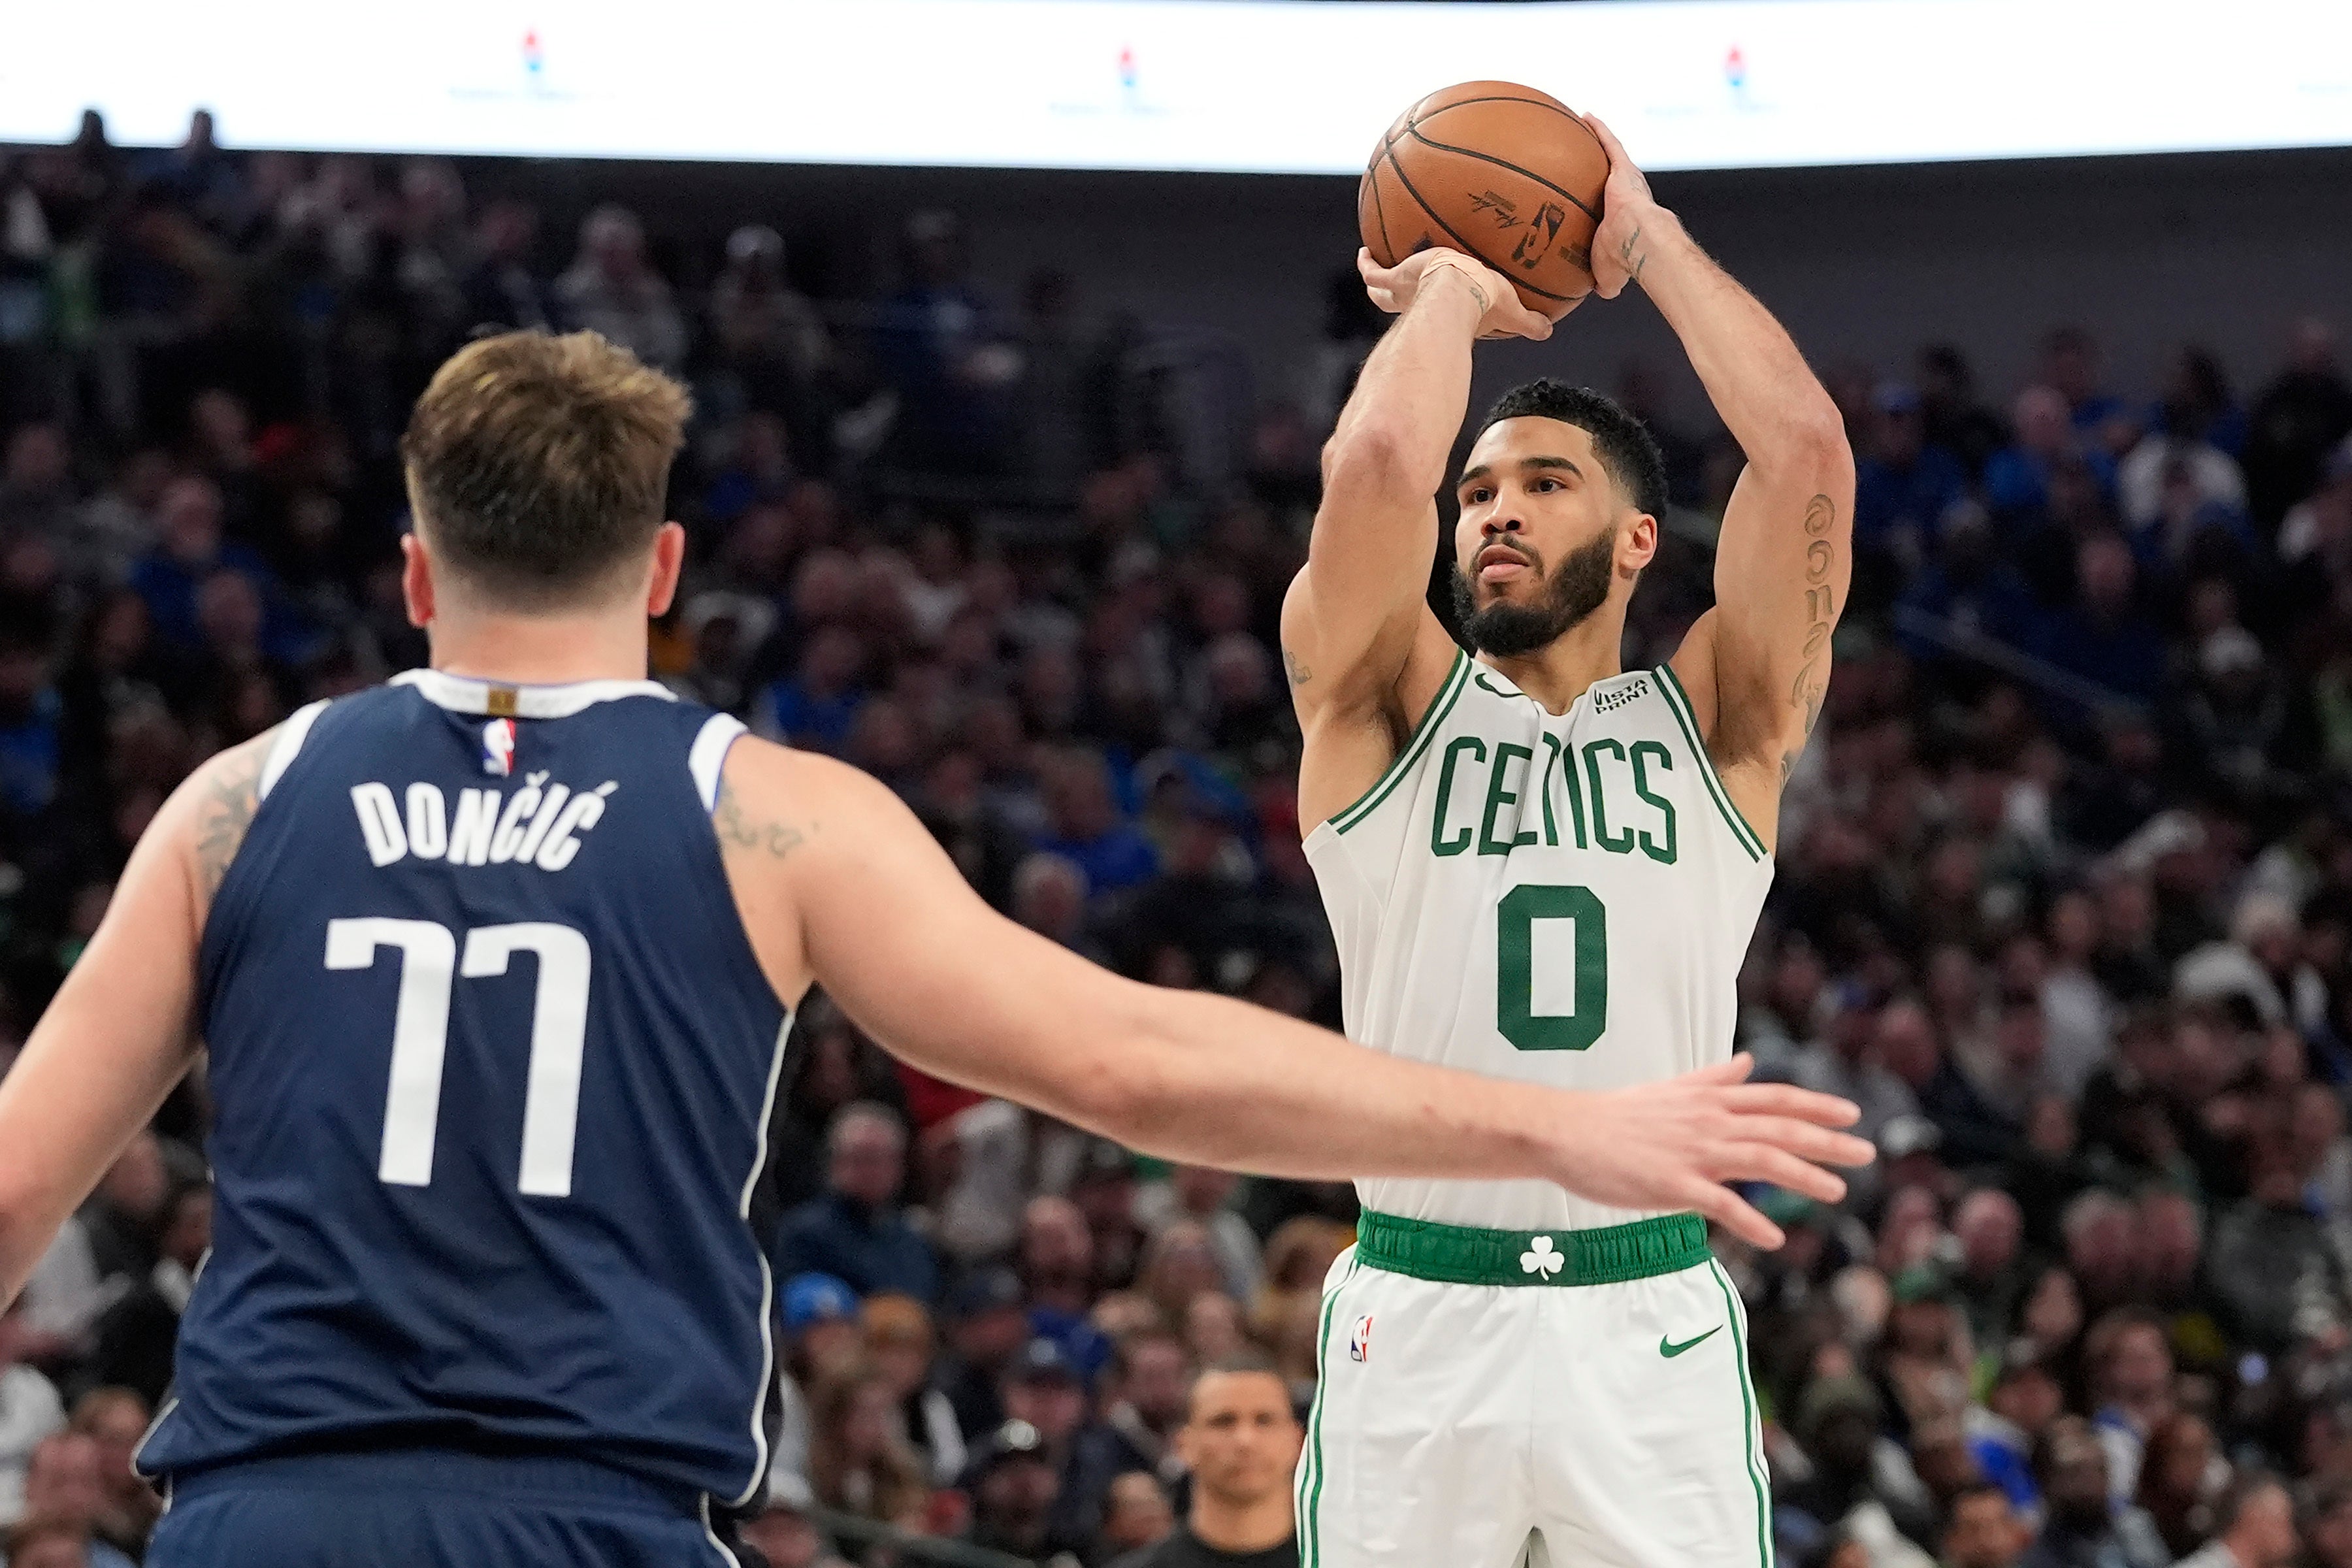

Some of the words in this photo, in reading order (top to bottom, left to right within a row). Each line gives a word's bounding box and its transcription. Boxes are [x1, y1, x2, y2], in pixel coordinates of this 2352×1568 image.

[1594, 679, 1646, 706] VISTA
[1595, 683, 1649, 715] PRINT
[350, 769, 620, 872] DONČIĆ
[1497, 884, 1608, 1051] 0
[323, 917, 592, 1198] 77
